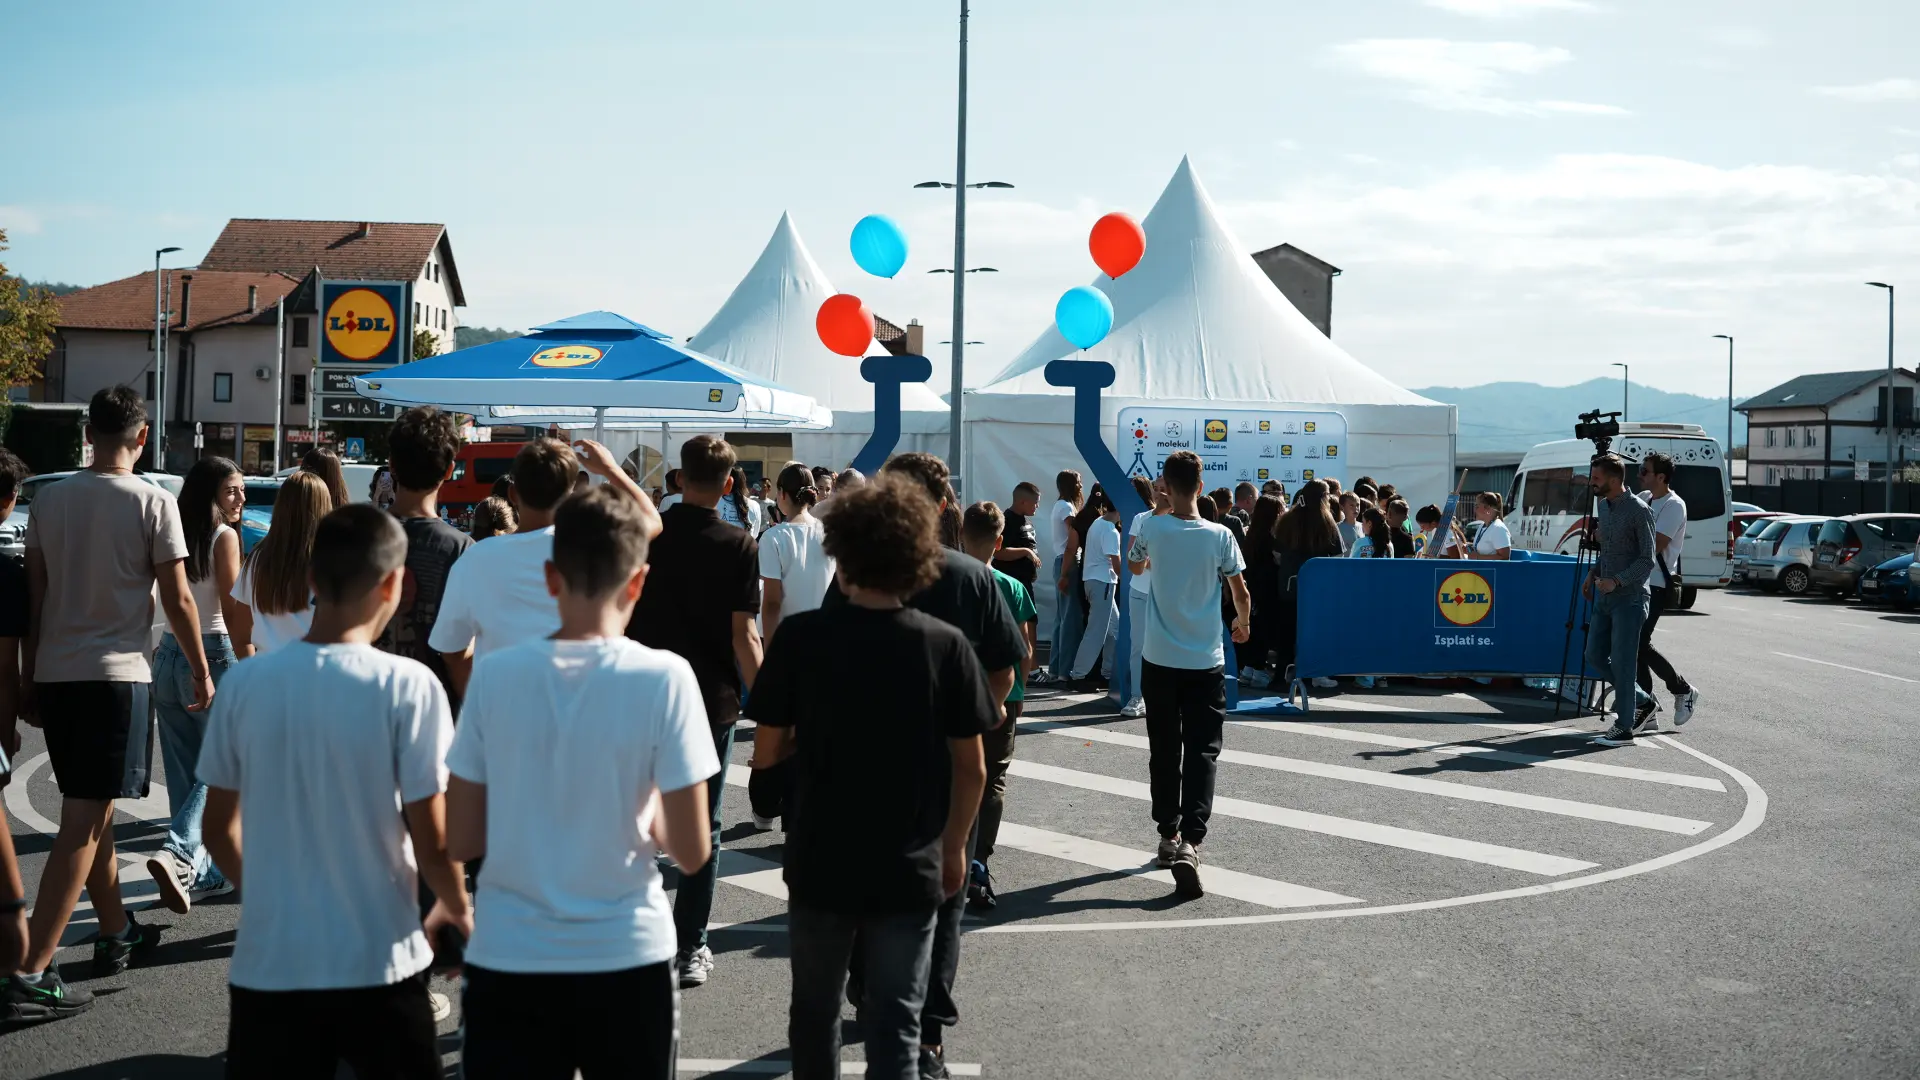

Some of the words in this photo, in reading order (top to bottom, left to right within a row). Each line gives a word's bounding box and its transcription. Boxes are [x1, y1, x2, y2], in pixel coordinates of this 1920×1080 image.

[1157, 440, 1189, 448] molekul
[1434, 634, 1475, 648] Isplati
[1477, 637, 1495, 646] se.
